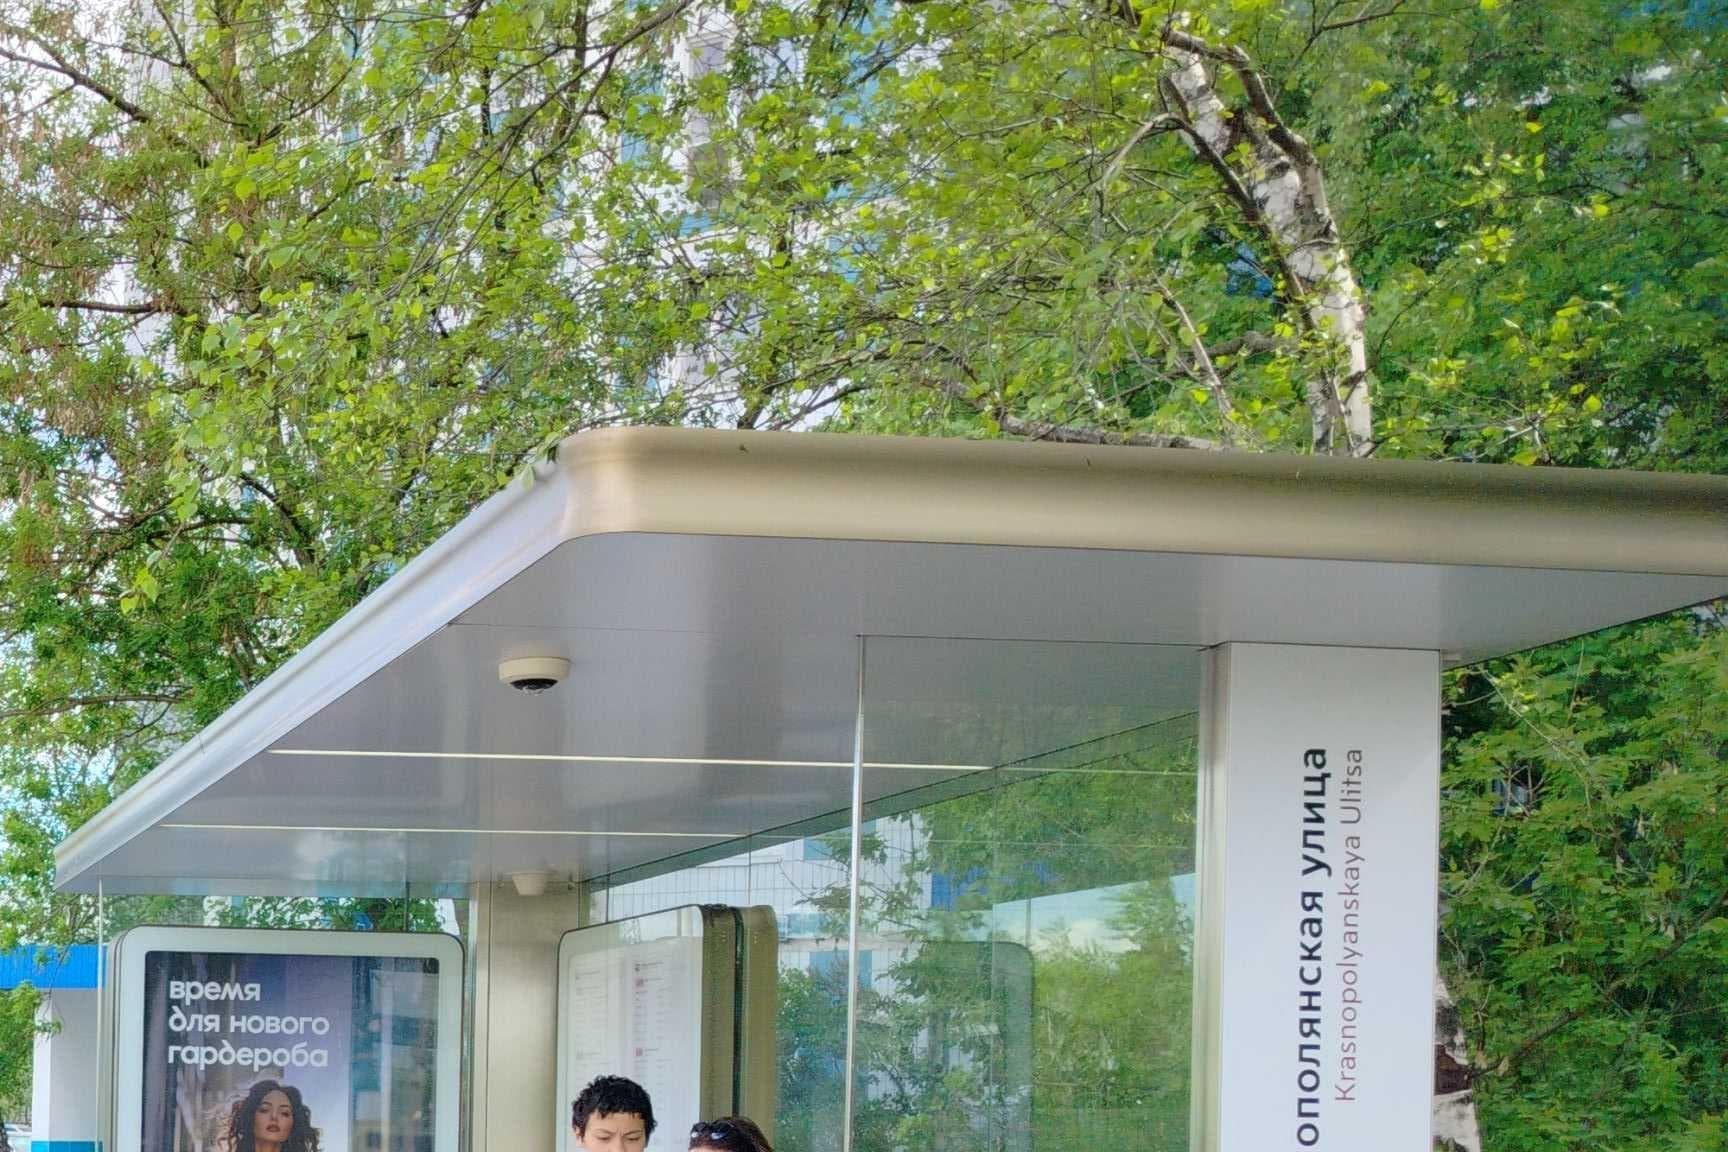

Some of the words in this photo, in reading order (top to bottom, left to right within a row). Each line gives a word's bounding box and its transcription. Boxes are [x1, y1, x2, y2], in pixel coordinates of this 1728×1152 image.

[1301, 748, 1332, 878] улица
[1339, 749, 1363, 824] Ulitsa
[169, 980, 261, 1006] время
[1334, 835, 1366, 1101] Krasnopolyanskaya
[168, 1005, 221, 1033] для
[230, 1015, 330, 1035] нового
[167, 1039, 329, 1073] гардероба
